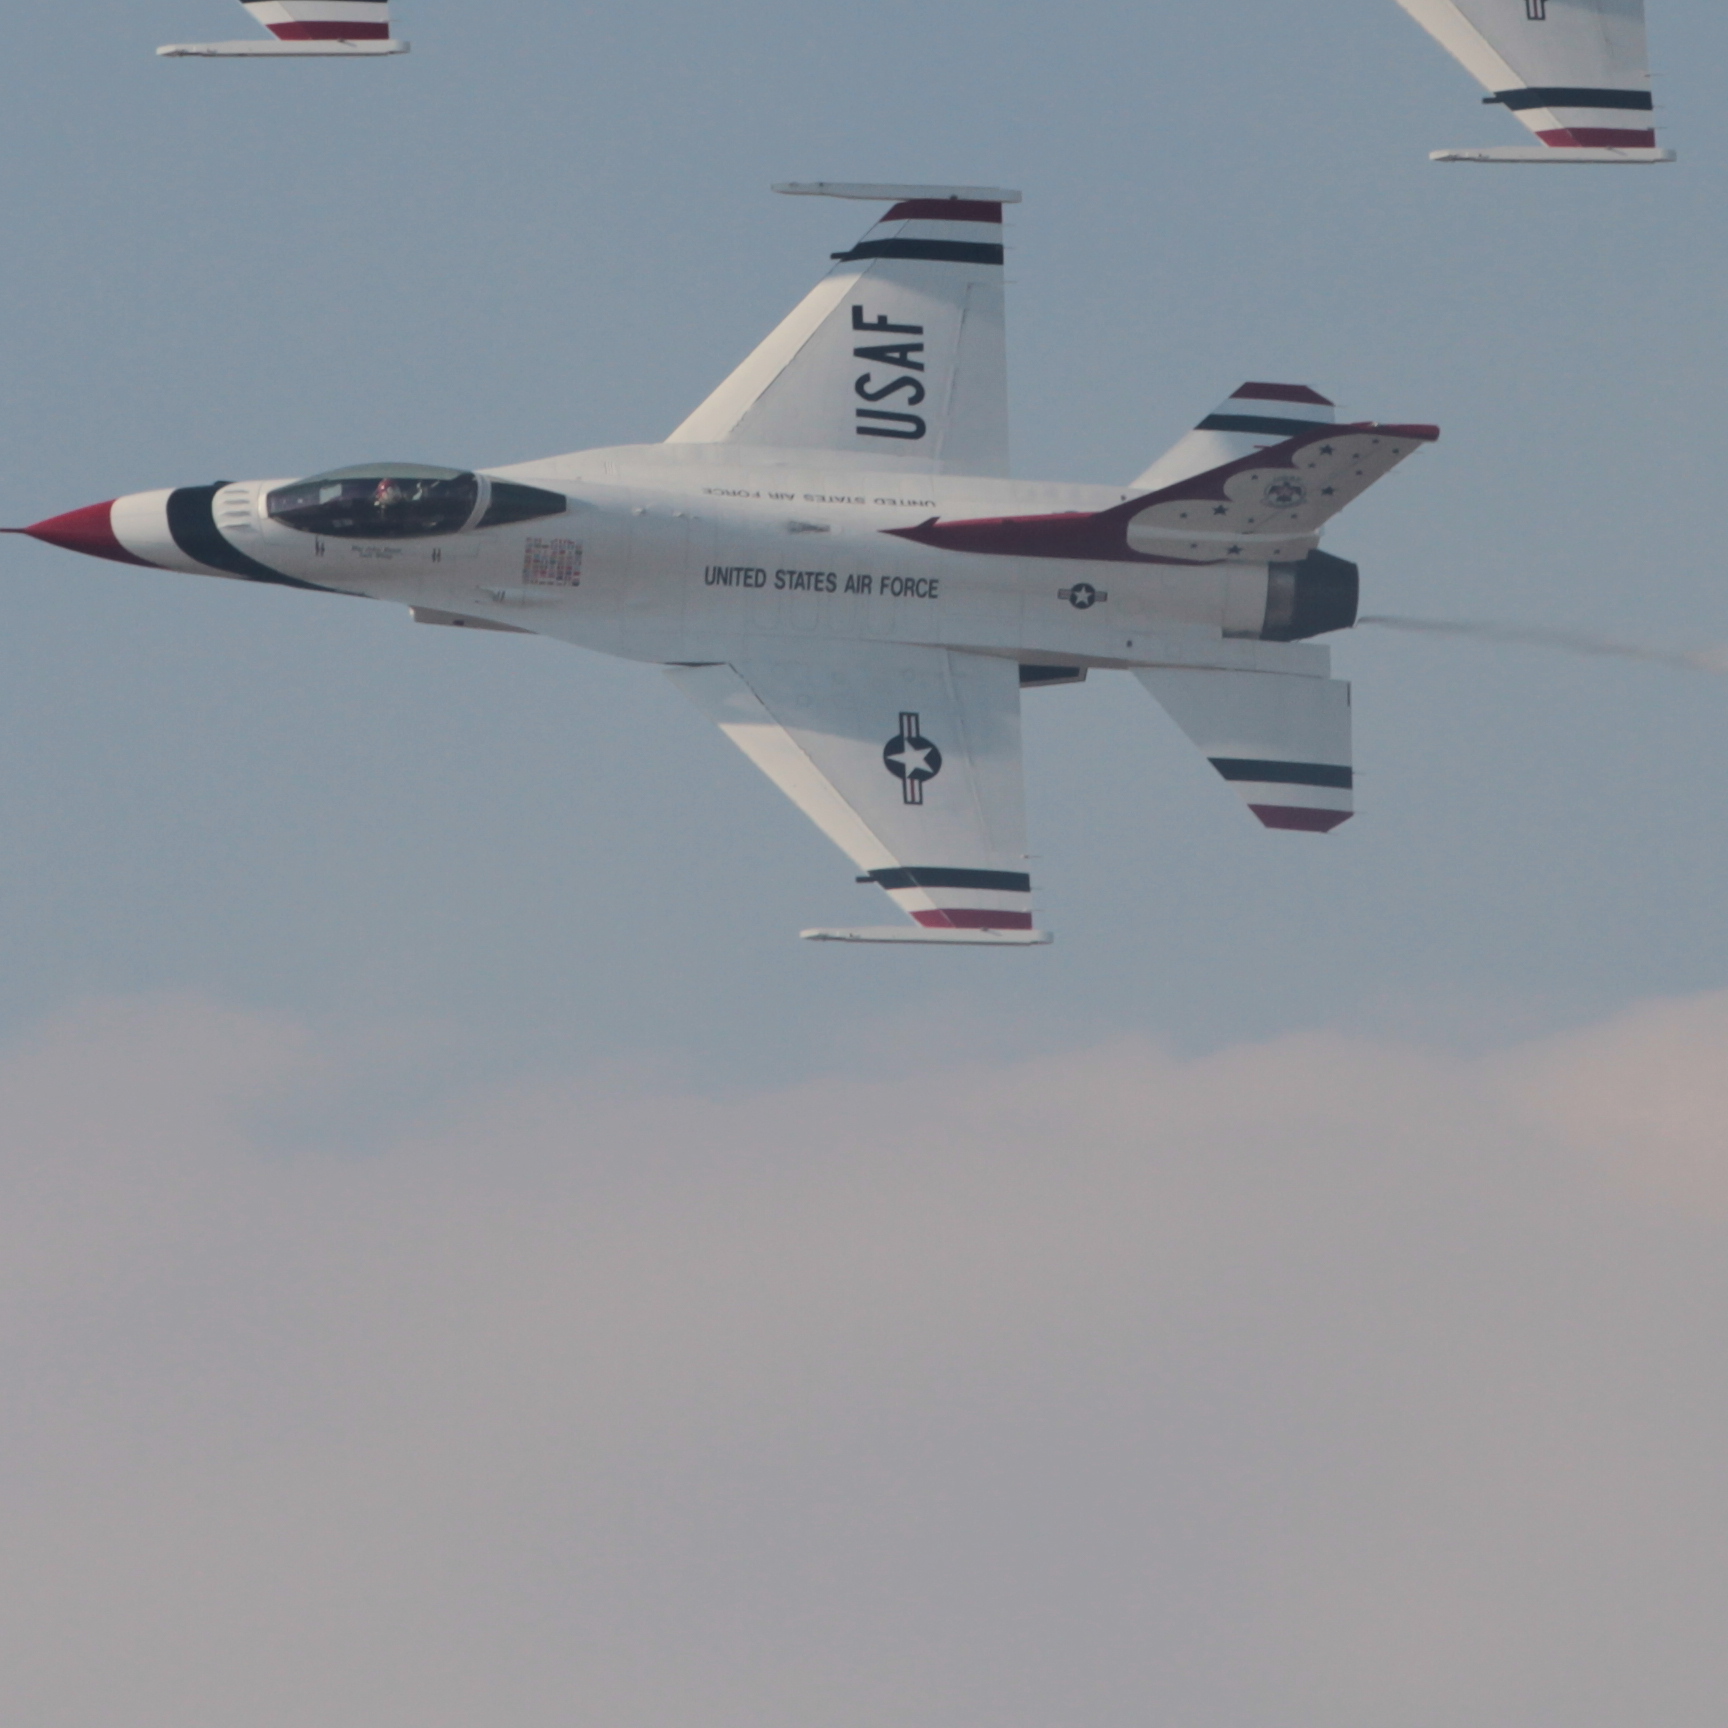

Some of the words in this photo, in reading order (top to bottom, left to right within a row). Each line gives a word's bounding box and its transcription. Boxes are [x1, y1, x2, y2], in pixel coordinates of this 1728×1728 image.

[851, 305, 926, 439] USAF
[704, 566, 766, 588] UNITED
[774, 569, 837, 593] STATES
[844, 574, 873, 595] AIR
[880, 576, 939, 599] FORCE
